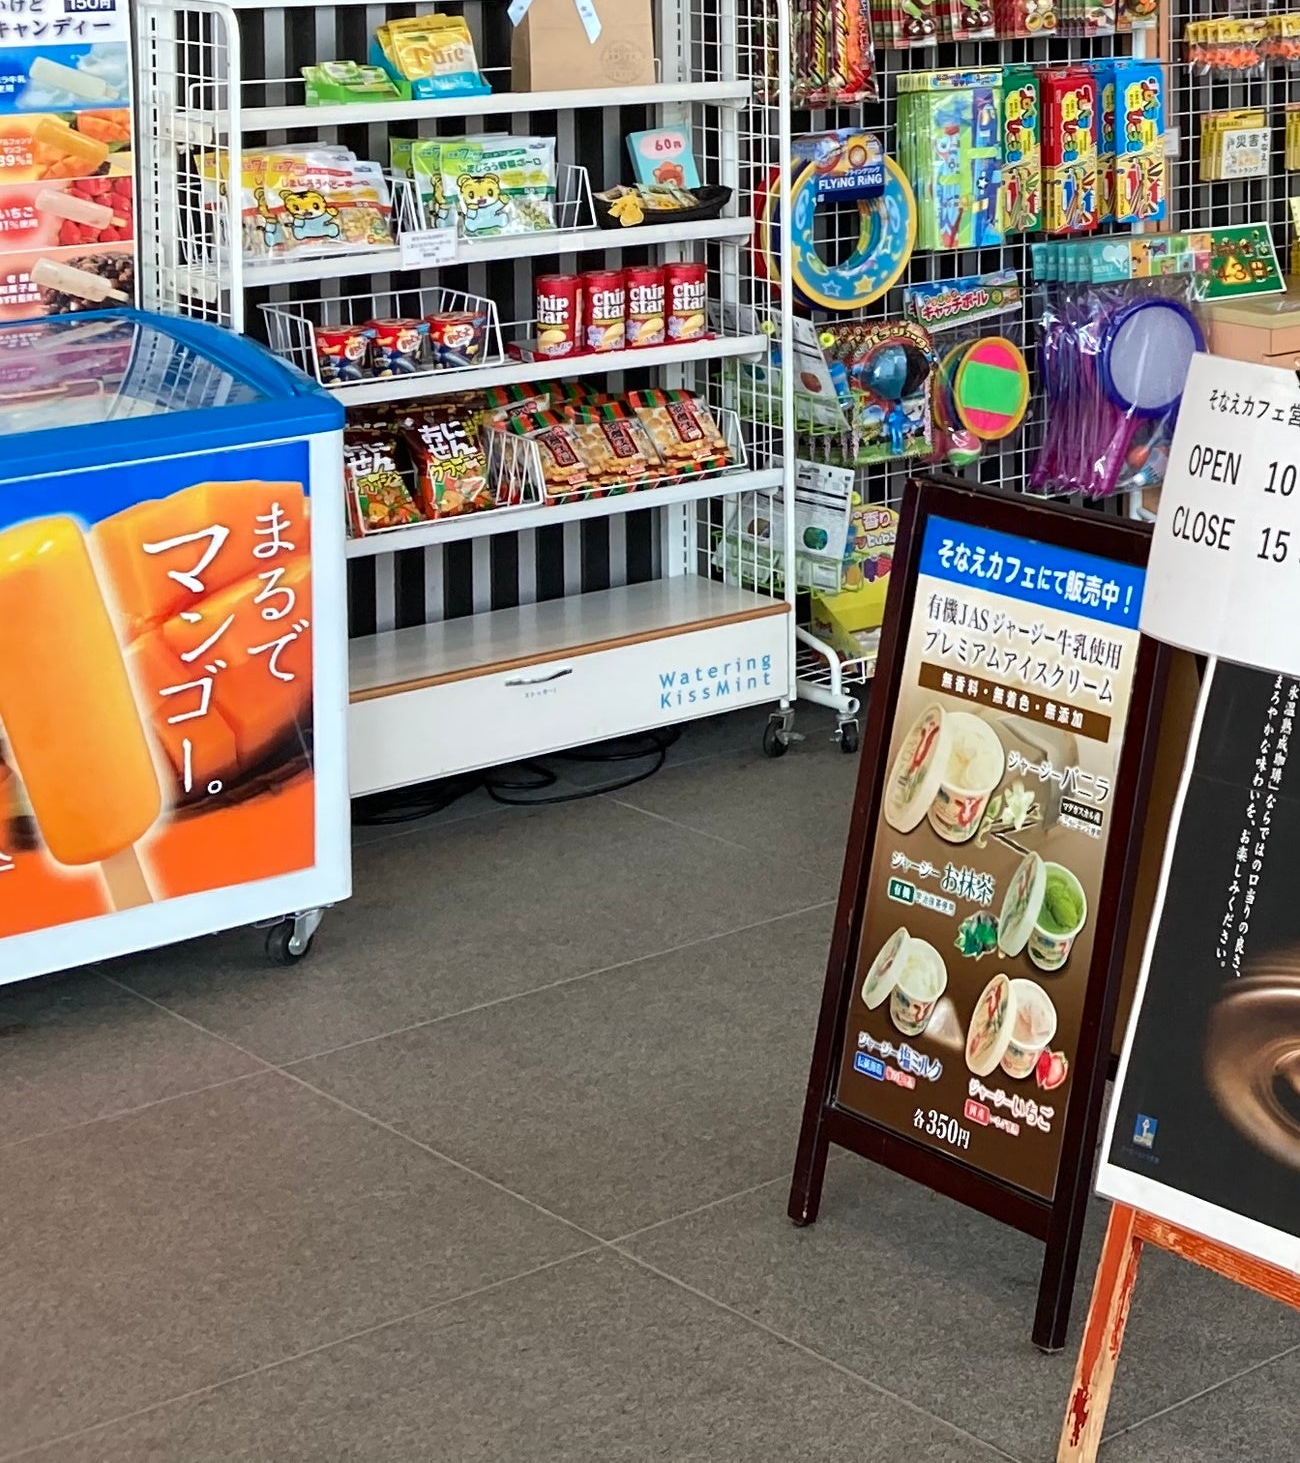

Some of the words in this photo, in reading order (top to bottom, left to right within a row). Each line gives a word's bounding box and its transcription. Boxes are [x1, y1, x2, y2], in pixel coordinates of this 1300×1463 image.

[921, 289, 989, 321] キャッチボール
[1188, 443, 1243, 487] OPEN
[1171, 504, 1237, 552] CLOSE
[247, 502, 310, 683] まるで
[141, 522, 237, 796] マンゴー。
[659, 653, 772, 689] Watering
[923, 629, 1115, 705] プレミアムアイスクリーム
[660, 672, 772, 709] KissMint
[940, 670, 1085, 730] 無香料・無着色・無添加
[1007, 749, 1112, 804] ジャージーバニラ
[890, 851, 996, 906] ジャージーお抹茶
[857, 1031, 944, 1082] ジャージー塩ミルク
[912, 1107, 971, 1150] 各350円
[968, 1078, 1055, 1133] ジャージーいちご
